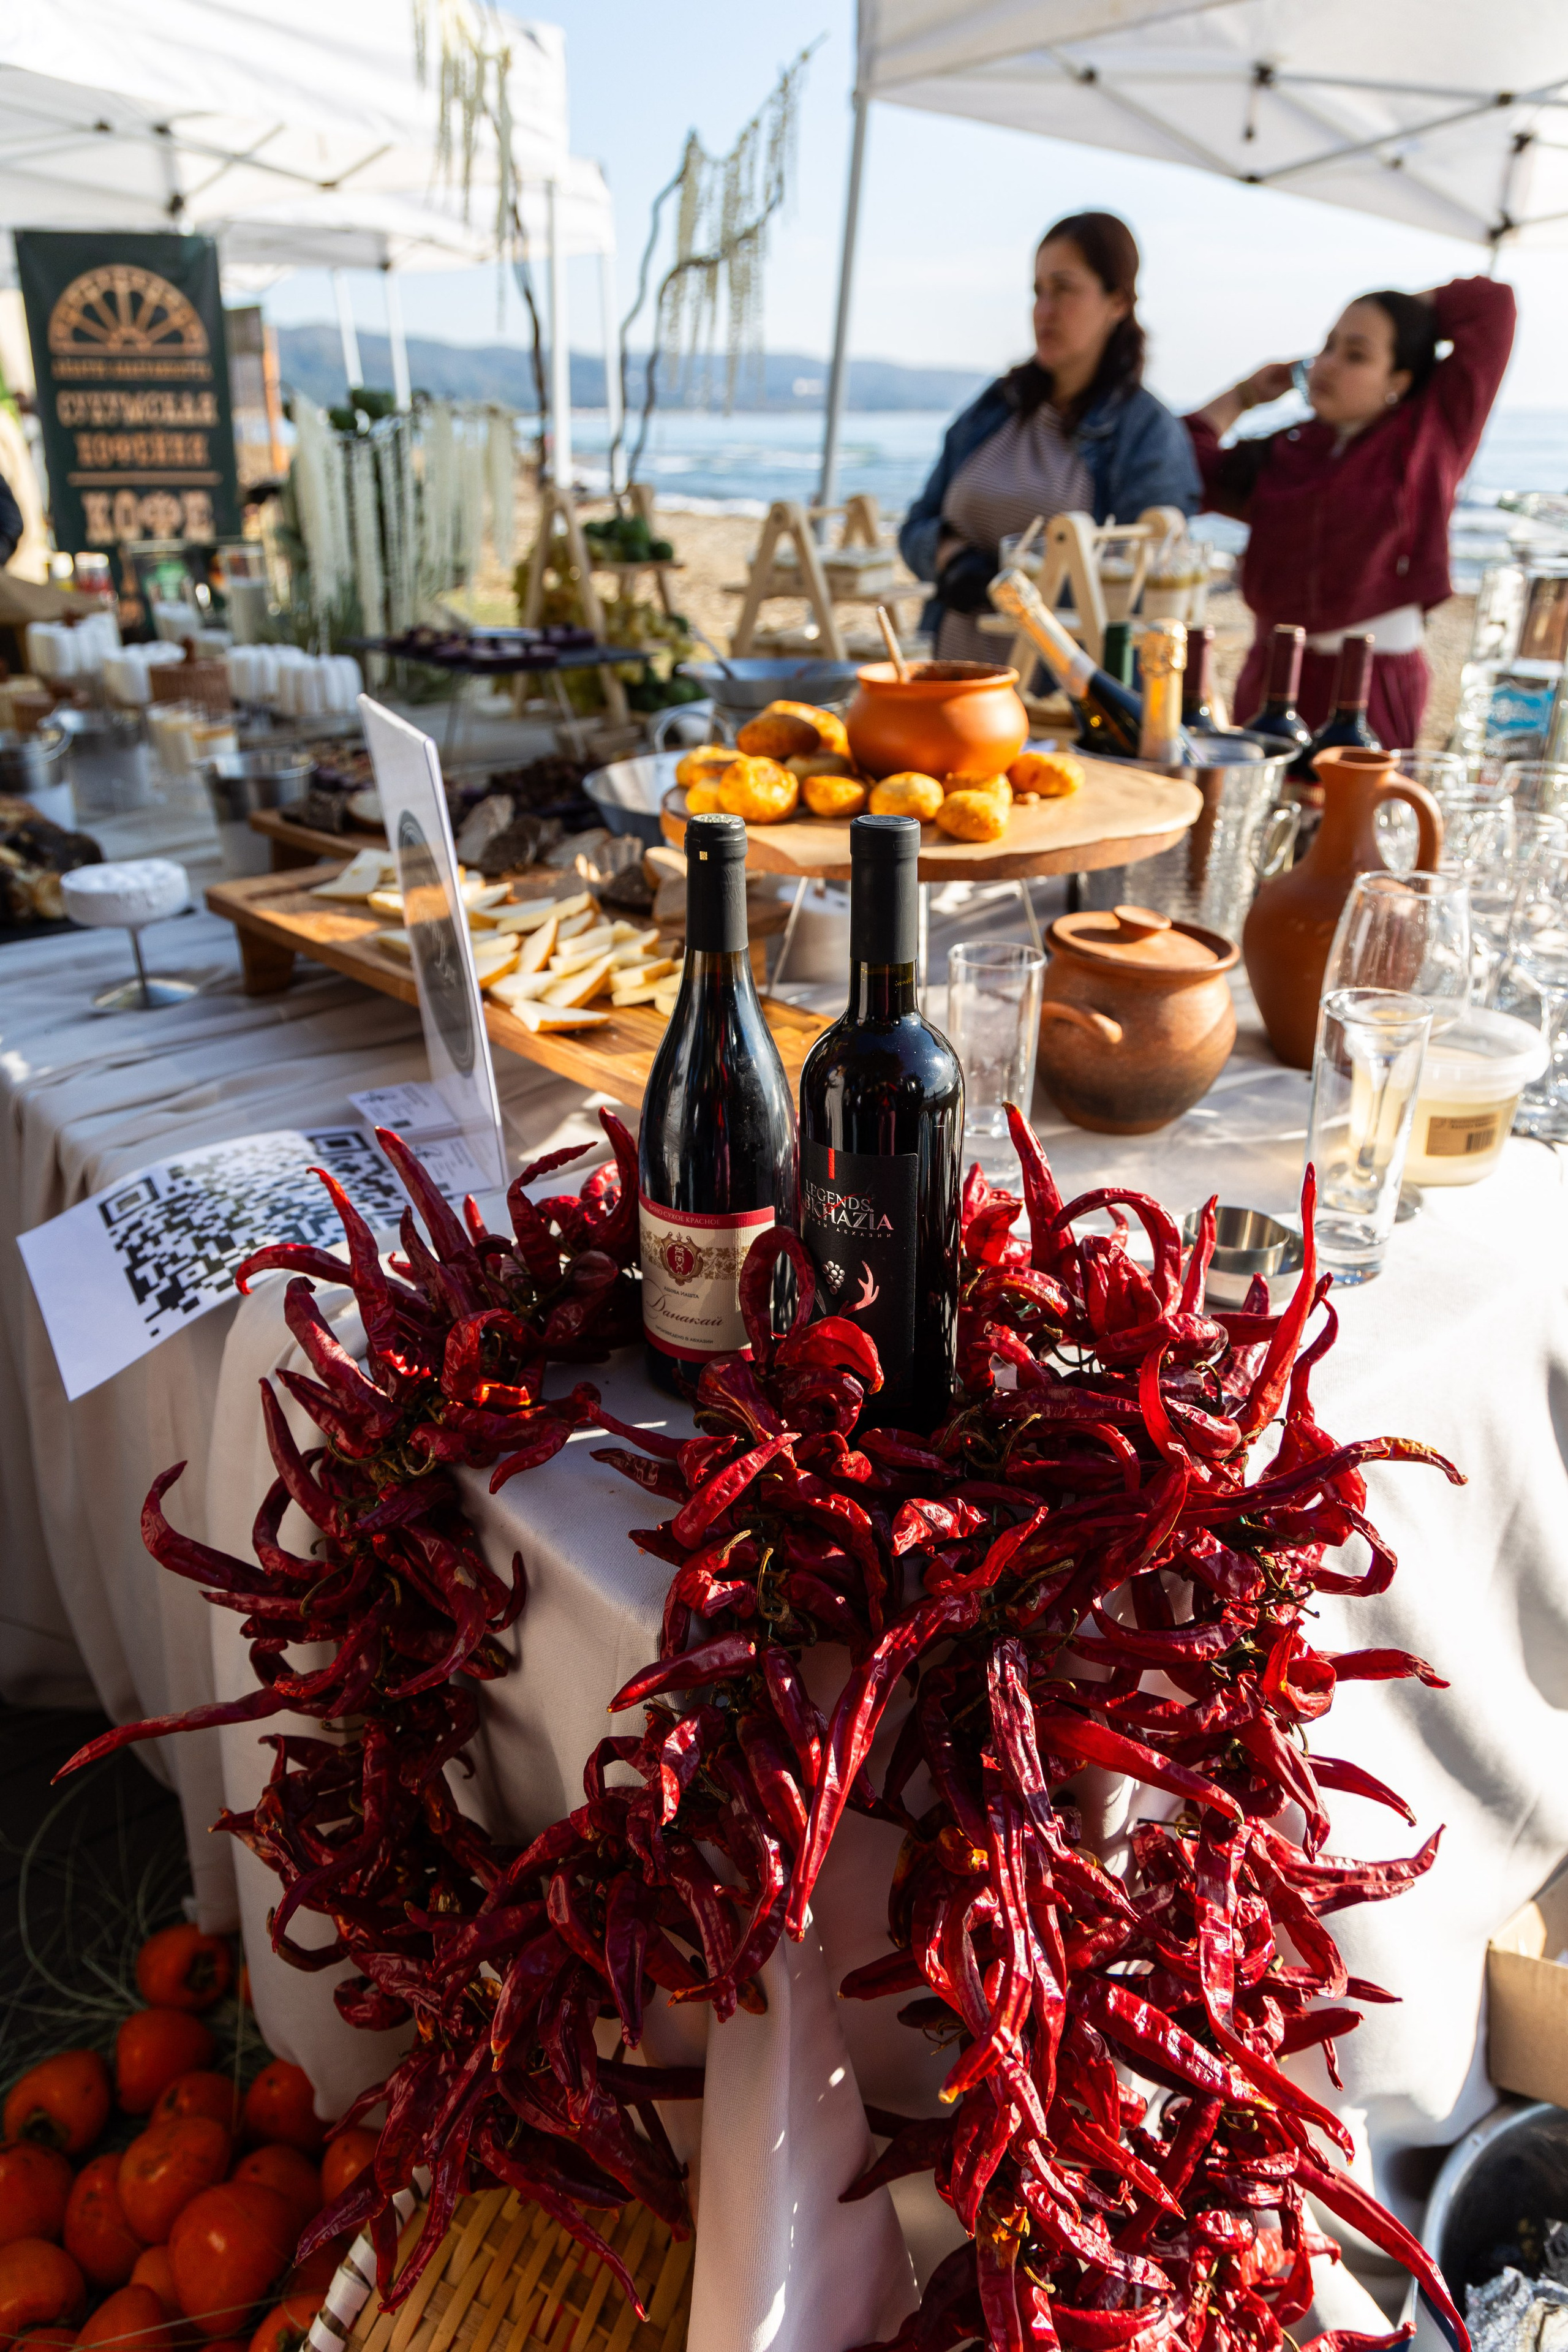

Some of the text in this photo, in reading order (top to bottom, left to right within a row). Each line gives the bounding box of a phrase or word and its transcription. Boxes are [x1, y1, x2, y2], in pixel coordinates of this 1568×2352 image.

[82, 491, 216, 545] КОФЕ
[802, 1190, 894, 1231] BKHAZIA
[805, 1178, 870, 1212] LEGENDS
[649, 1203, 720, 1226] ВИНО СУХОЕ КРАСНОЕ
[836, 1227, 892, 1238] АБХАЗИИ
